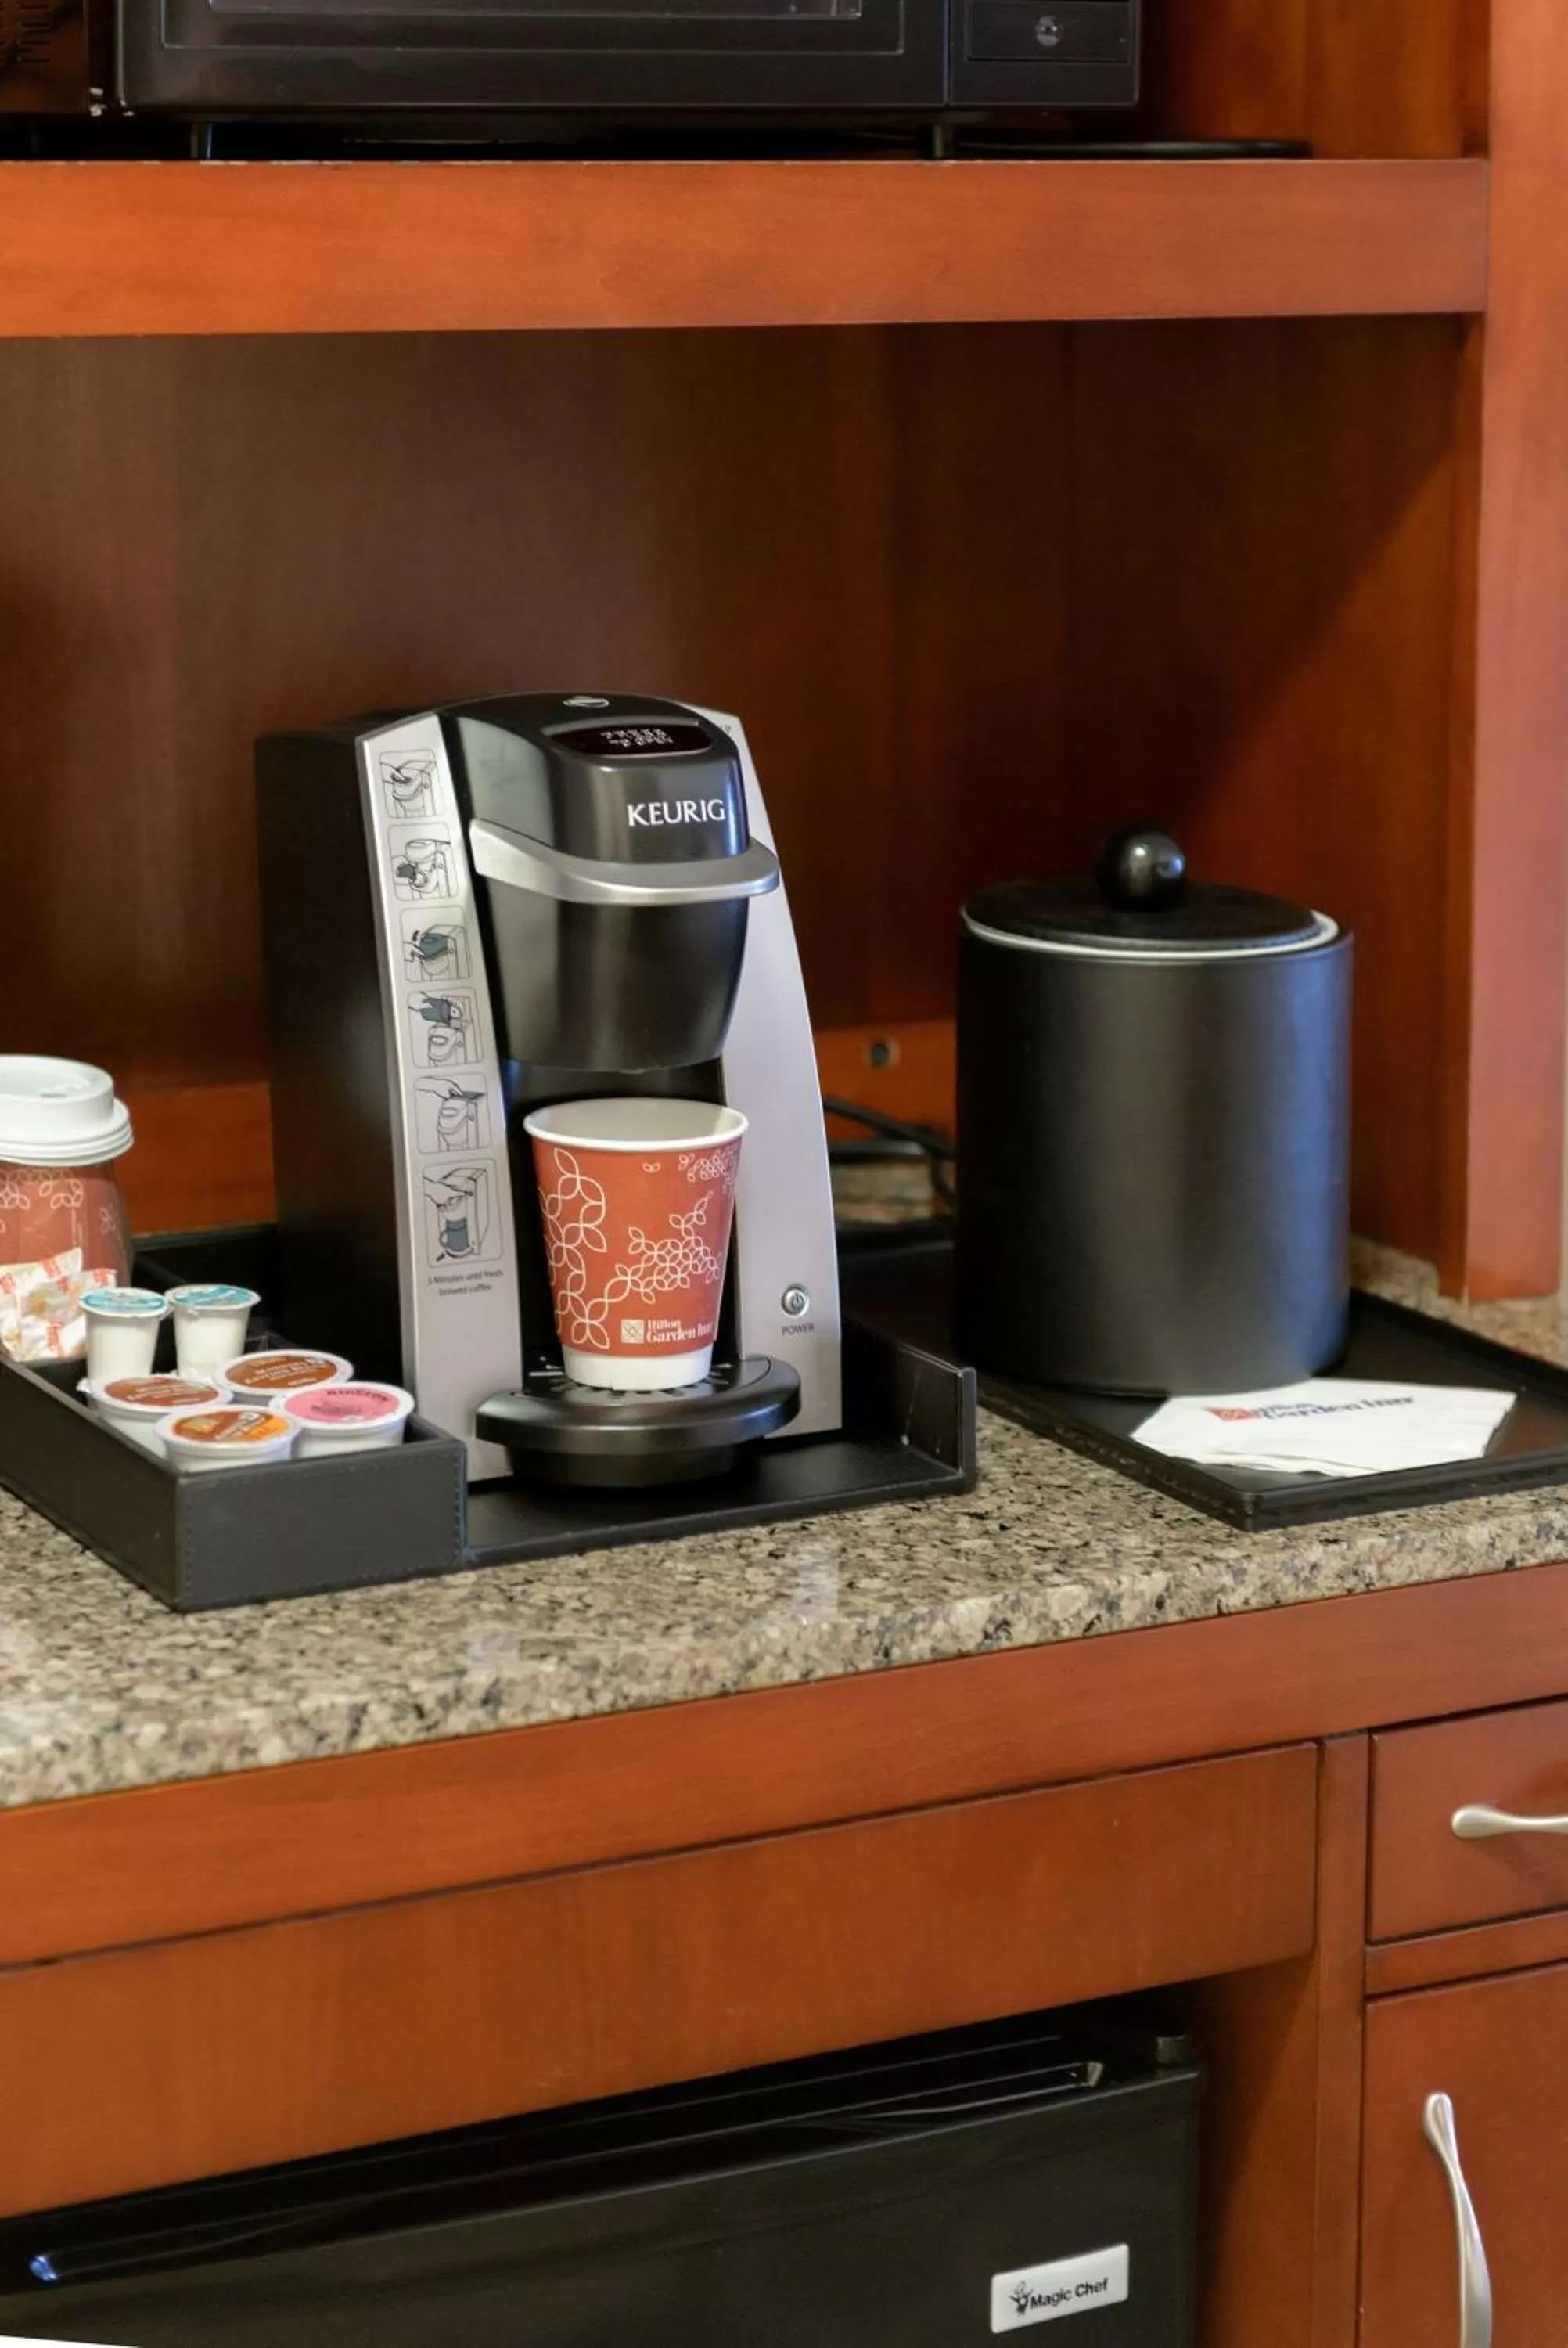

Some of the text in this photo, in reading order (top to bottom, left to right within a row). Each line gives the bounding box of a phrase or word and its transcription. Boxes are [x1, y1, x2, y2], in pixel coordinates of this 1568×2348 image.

[627, 798, 726, 827] KEURIG
[646, 1327, 696, 1343] Garden
[1030, 2278, 1109, 2309] Magic Chef
